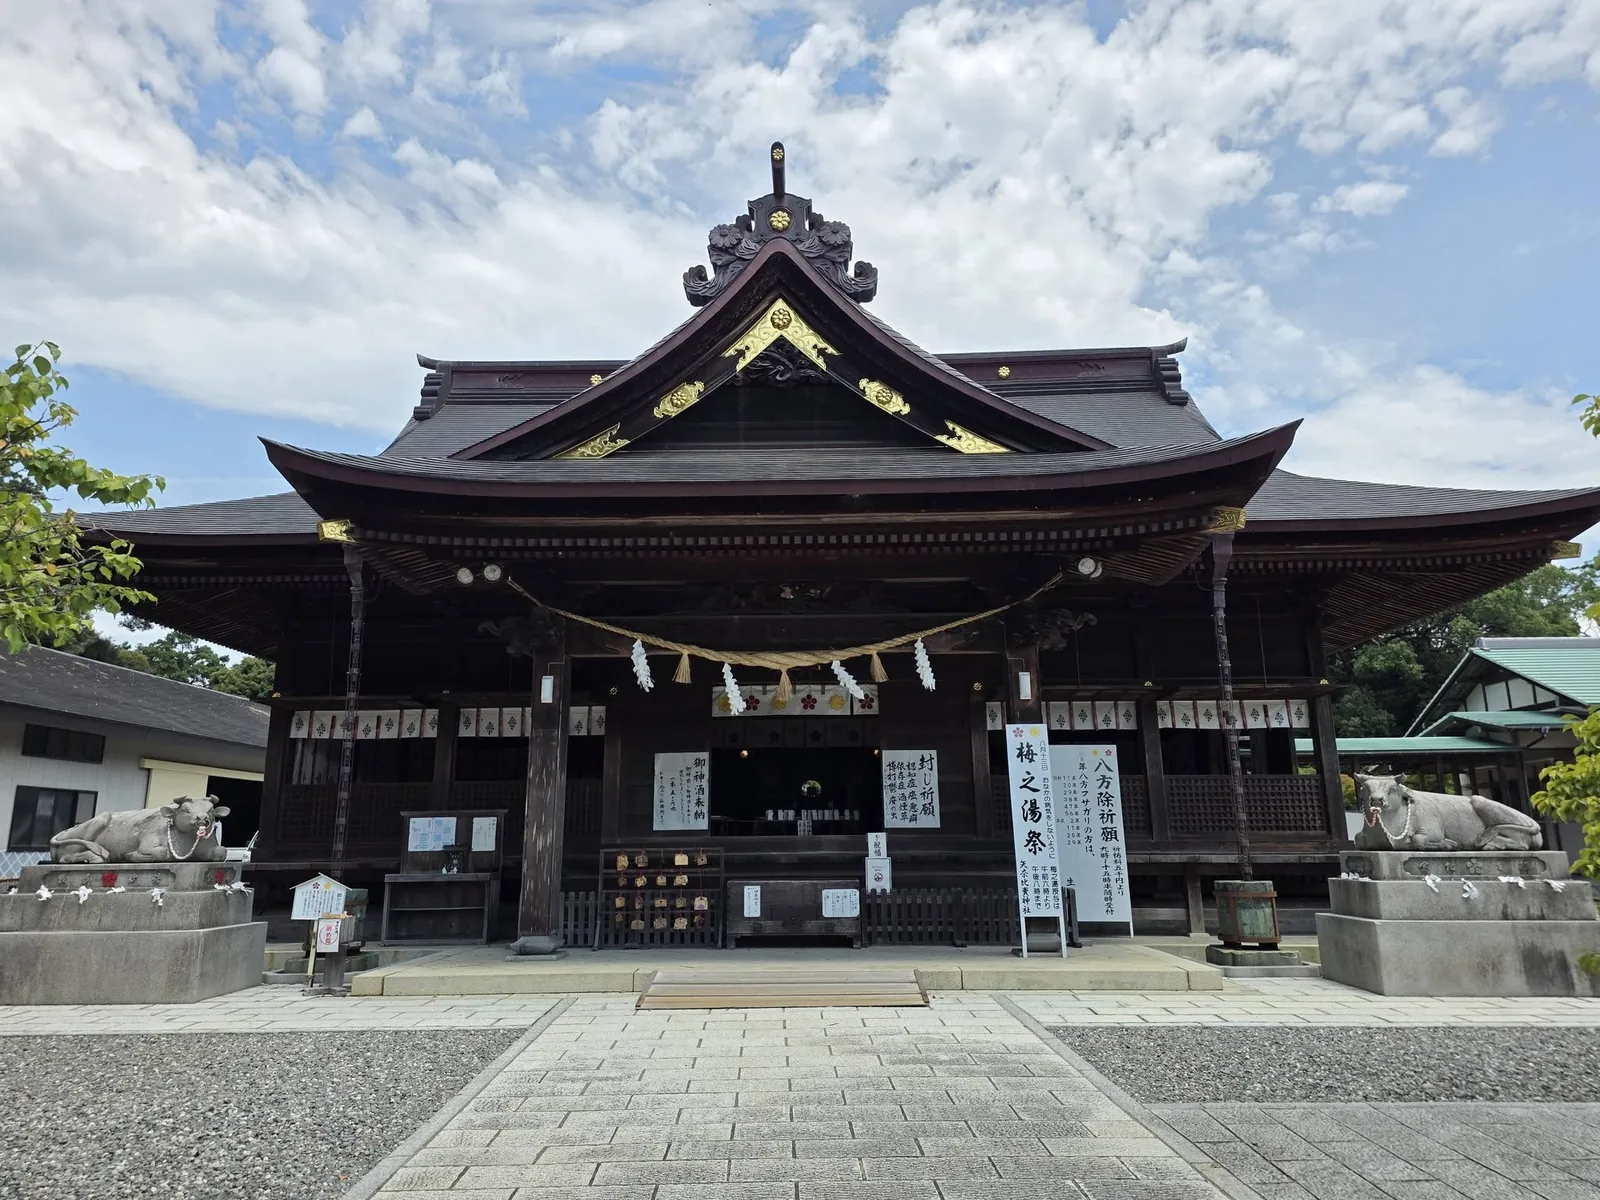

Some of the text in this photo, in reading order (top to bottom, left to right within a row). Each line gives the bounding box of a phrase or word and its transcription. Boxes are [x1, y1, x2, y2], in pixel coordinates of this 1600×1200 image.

[1039, 740, 1049, 772] 八月十三日
[693, 757, 705, 820] 御神酒奉納
[918, 752, 936, 817] 封じ祈願
[1016, 741, 1046, 856] 梅之湯祭
[1094, 758, 1119, 843] 八方除祈願
[1032, 865, 1042, 910] 午後八時まで
[1041, 865, 1051, 910] 午前六時より
[1050, 865, 1060, 910] 梅之湯授与は
